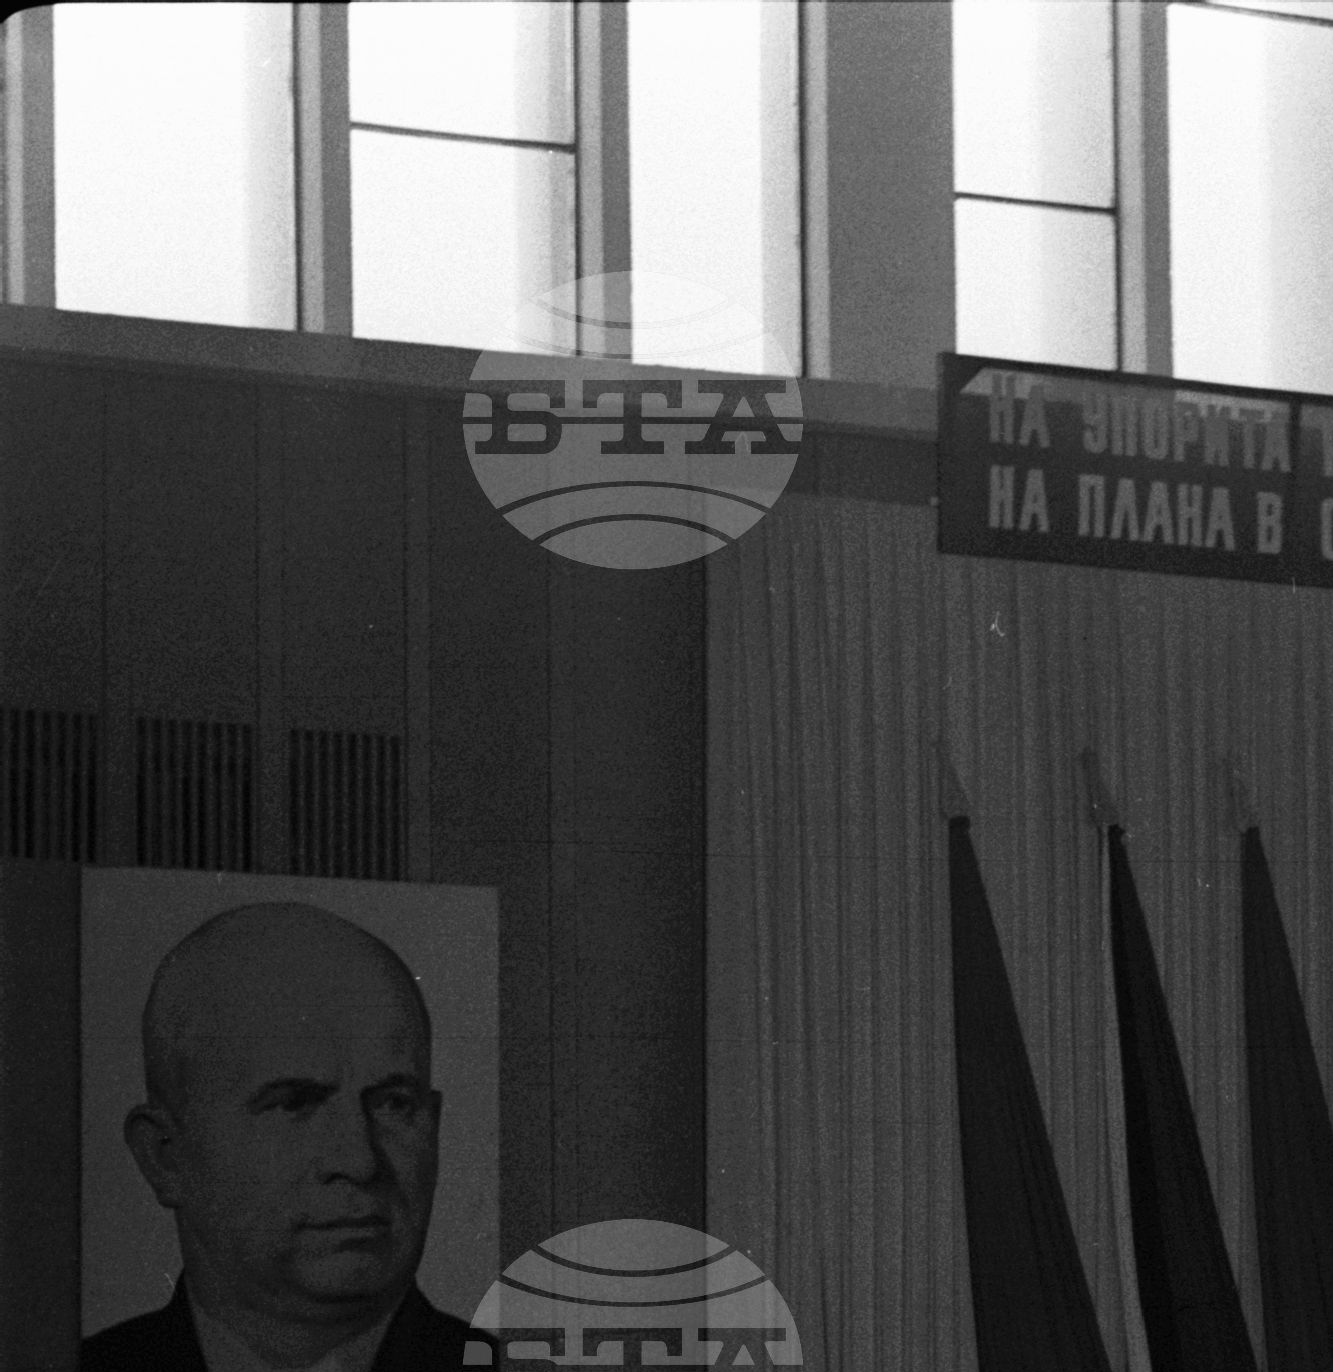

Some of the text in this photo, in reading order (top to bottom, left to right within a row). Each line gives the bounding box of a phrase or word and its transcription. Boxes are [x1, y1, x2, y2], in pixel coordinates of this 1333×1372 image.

[989, 374, 1050, 448] НА
[1083, 390, 1291, 473] УПОРИТА
[988, 465, 1051, 534] НА
[1077, 474, 1237, 553] ПЛАНА
[1256, 491, 1284, 555] В
